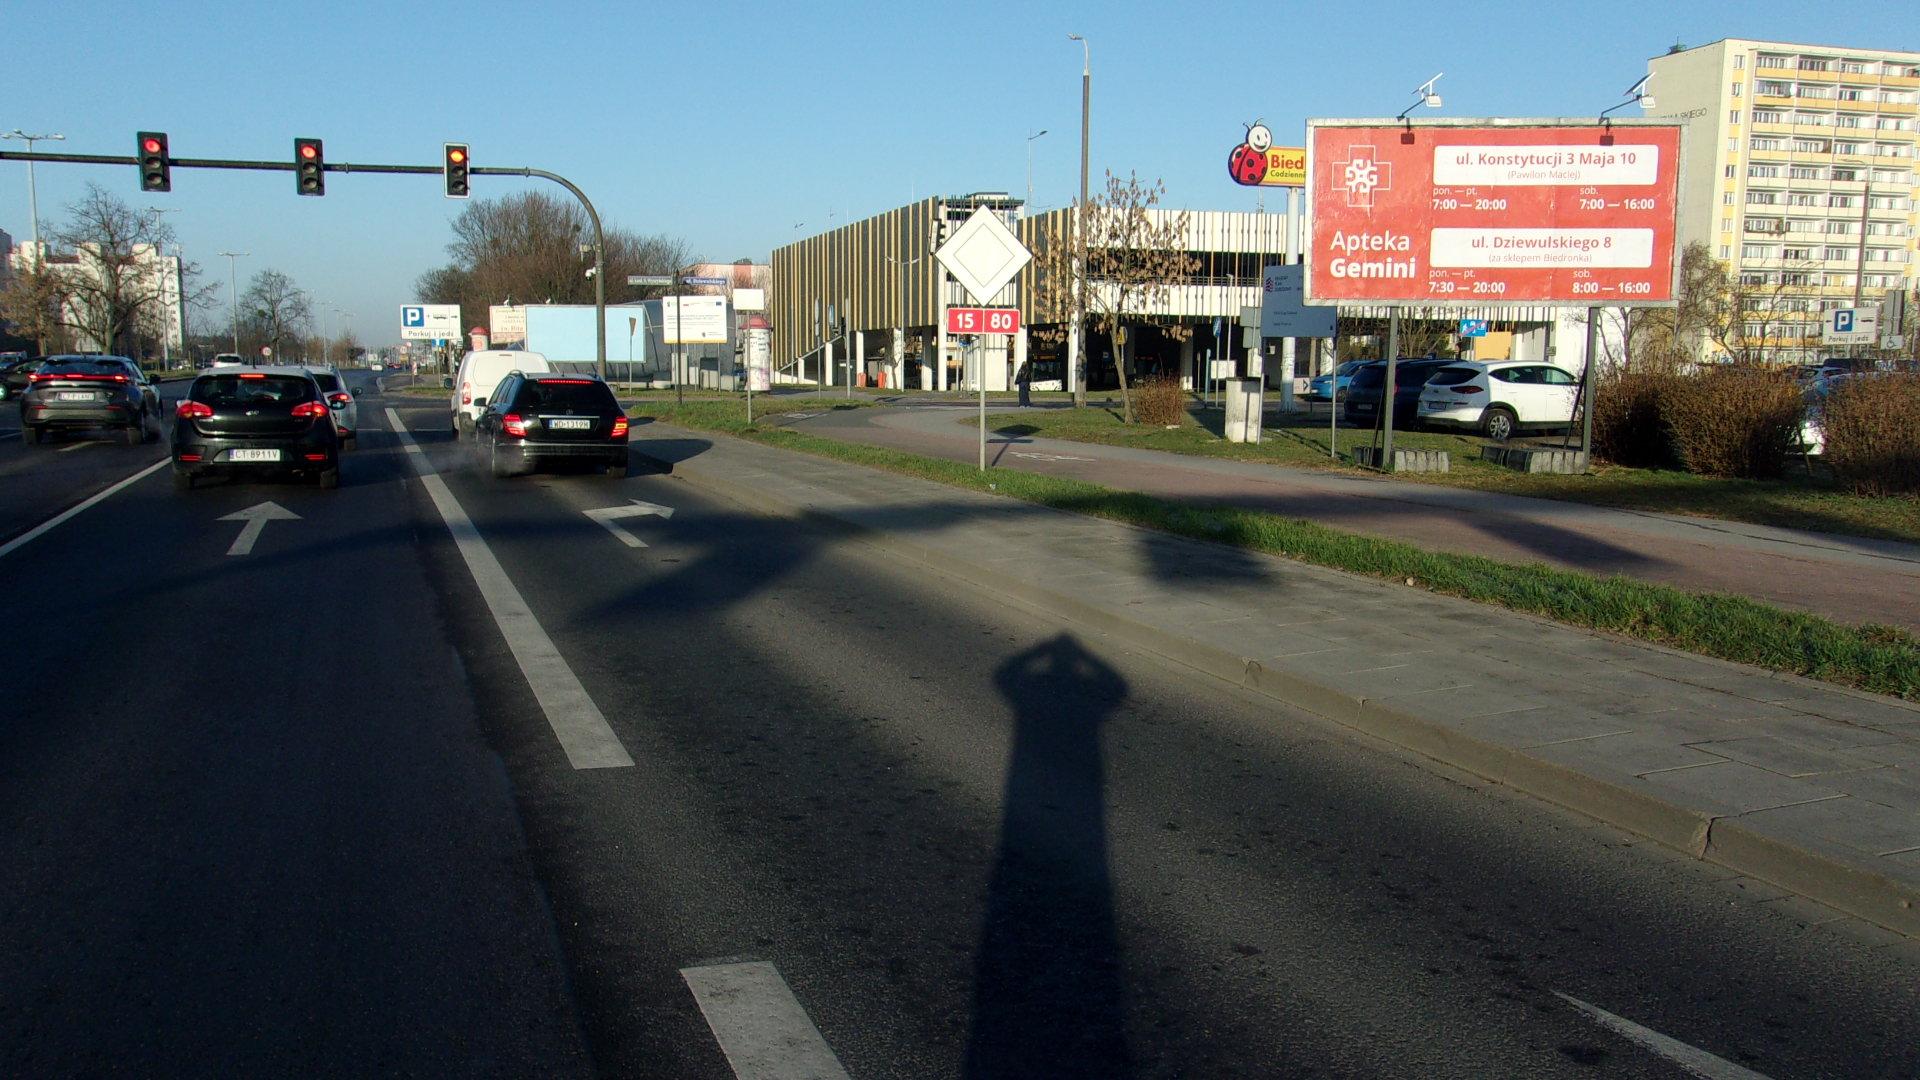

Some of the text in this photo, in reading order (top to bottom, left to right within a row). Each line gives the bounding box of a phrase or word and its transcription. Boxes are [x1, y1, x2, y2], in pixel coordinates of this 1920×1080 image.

[1270, 154, 1304, 170] Bied
[1456, 152, 1636, 169] ul. Konstytucji 3 Maja 10
[1507, 169, 1581, 180] (Pawilon Maciej)
[1433, 188, 1452, 198] pon.
[1466, 187, 1477, 198] pt.
[1580, 186, 1598, 195] sob.
[1433, 199, 1457, 210] 7:00
[1475, 199, 1506, 210] 20:00
[1580, 199, 1604, 209] 7:00
[1624, 199, 1654, 210] 16:00
[1330, 230, 1410, 256] Apteka
[1471, 236, 1612, 251] ul. Dziewulskiego 8
[1488, 253, 1592, 264] (za sklepem Biedronka)
[1330, 257, 1416, 278] Gemini
[1429, 270, 1449, 280] pon.
[1464, 269, 1476, 279] pt.
[1573, 269, 1592, 278] sob.
[1428, 282, 1454, 293] 7:30
[1473, 282, 1505, 294] 20:00
[1572, 282, 1598, 293] 8:00
[1618, 282, 1650, 293] 16:00
[957, 312, 1012, 330] 15 80
